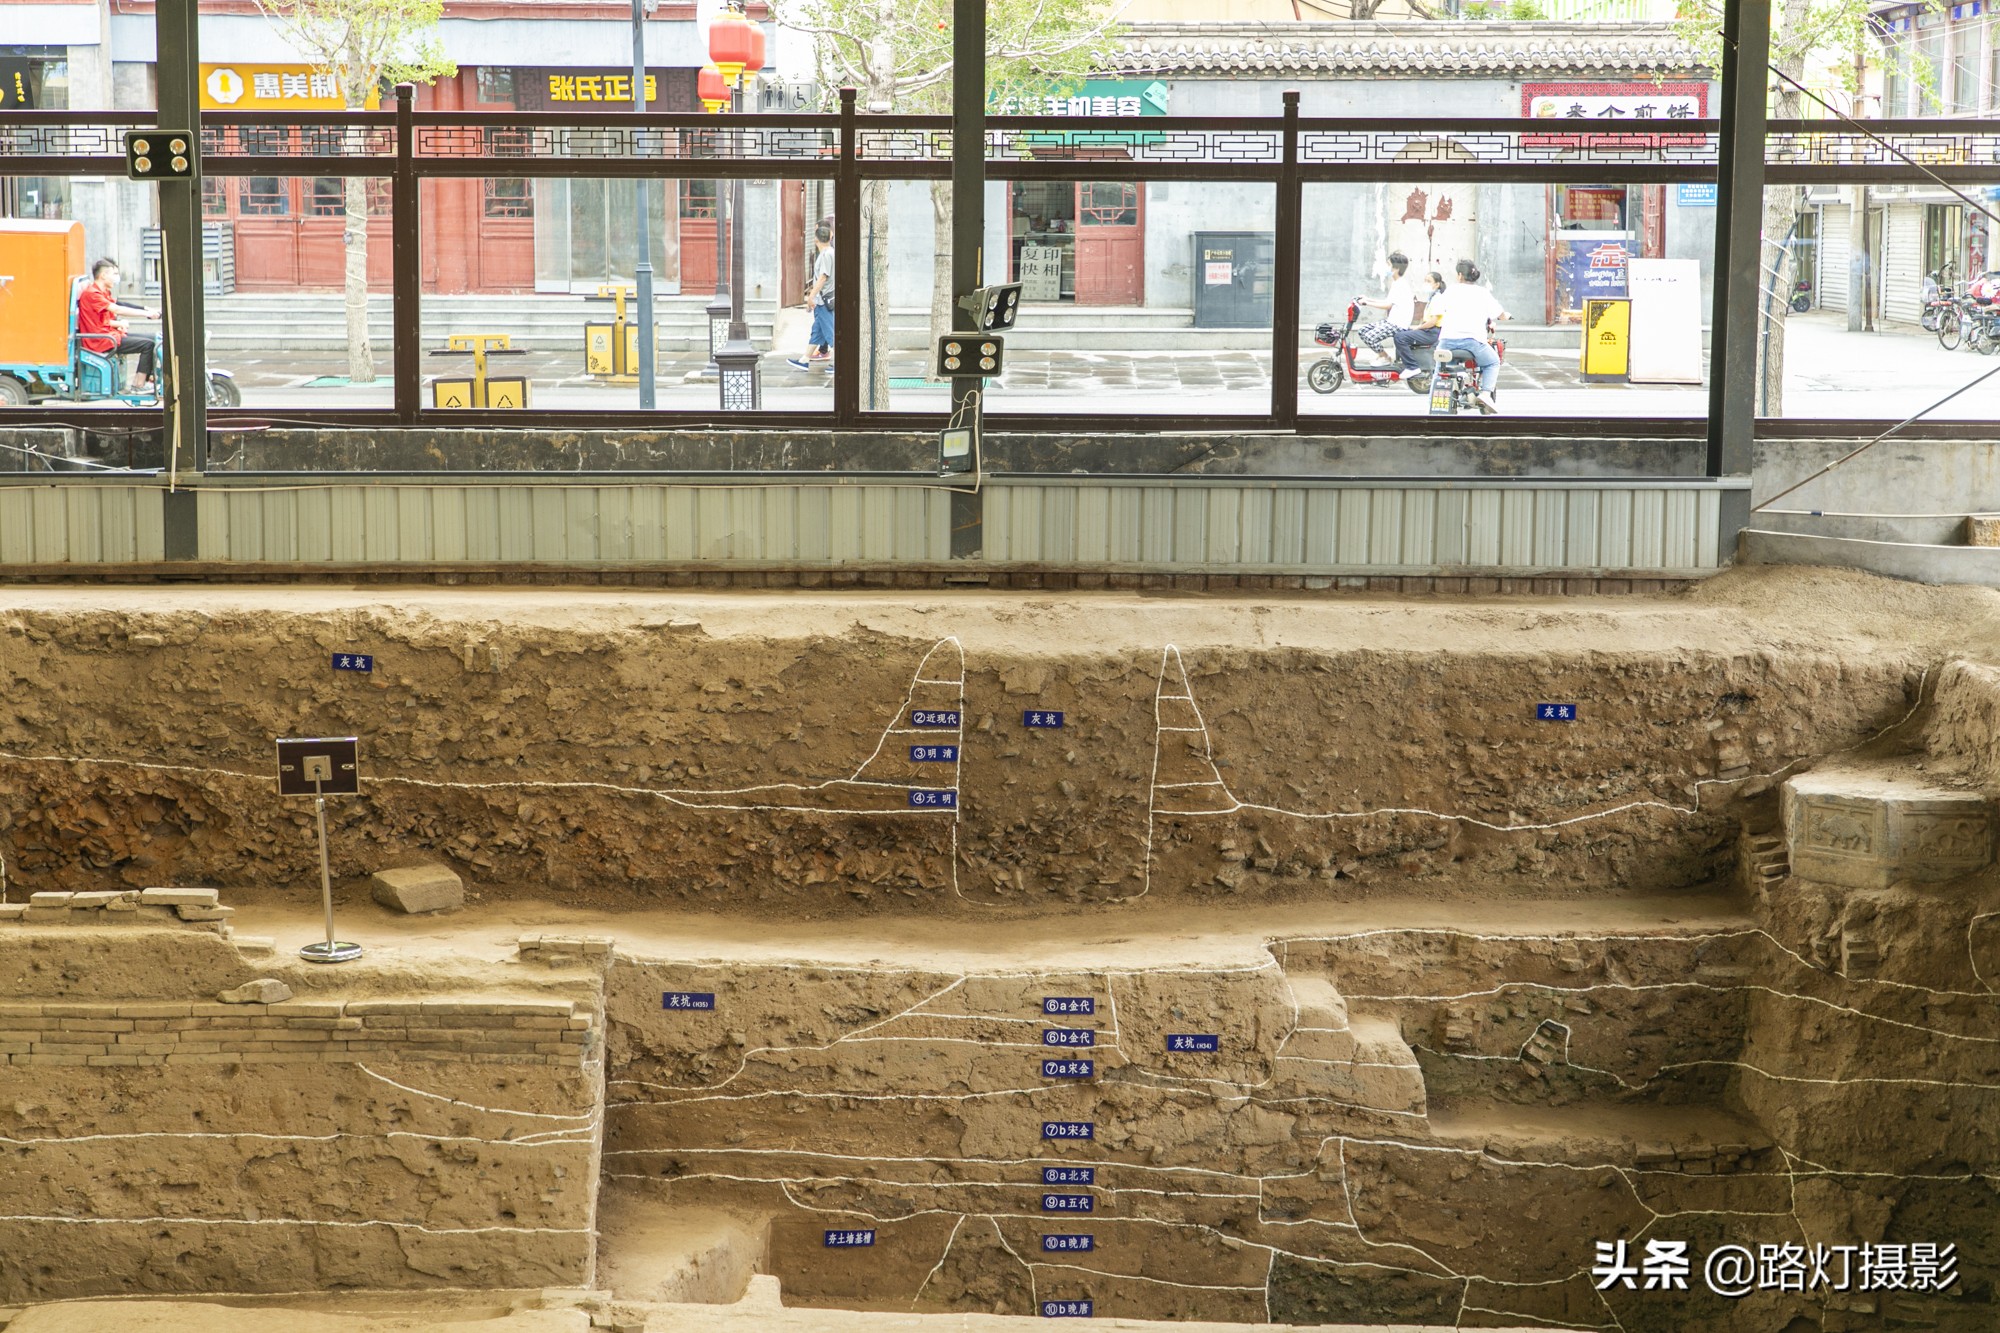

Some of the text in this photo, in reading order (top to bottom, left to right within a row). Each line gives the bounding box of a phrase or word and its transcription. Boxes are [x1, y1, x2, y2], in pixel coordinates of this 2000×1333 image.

[1024, 248, 1059, 261] 复印
[1022, 263, 1059, 276] 快相
[341, 656, 365, 668] 灰坑
[1545, 706, 1568, 717] 灰坑
[914, 712, 956, 724] ②近现代
[1032, 713, 1055, 724] 灰坑
[914, 748, 952, 759] ③明清
[913, 793, 950, 804] ④元明
[670, 995, 690, 1007] 灰坑
[1047, 999, 1090, 1011] ⑥a金代
[1045, 1031, 1089, 1045] ⑥b金代
[1175, 1037, 1194, 1048] 灰坑
[1046, 1062, 1089, 1074] ⑦a宋金
[1046, 1124, 1089, 1136] ⑦b宋金
[1046, 1170, 1089, 1181] ⑧a北宋
[1046, 1197, 1088, 1209] ⑨a五代
[1046, 1237, 1089, 1248] ⑩a晚唐
[1046, 1303, 1088, 1315] ⑩b晚唐
